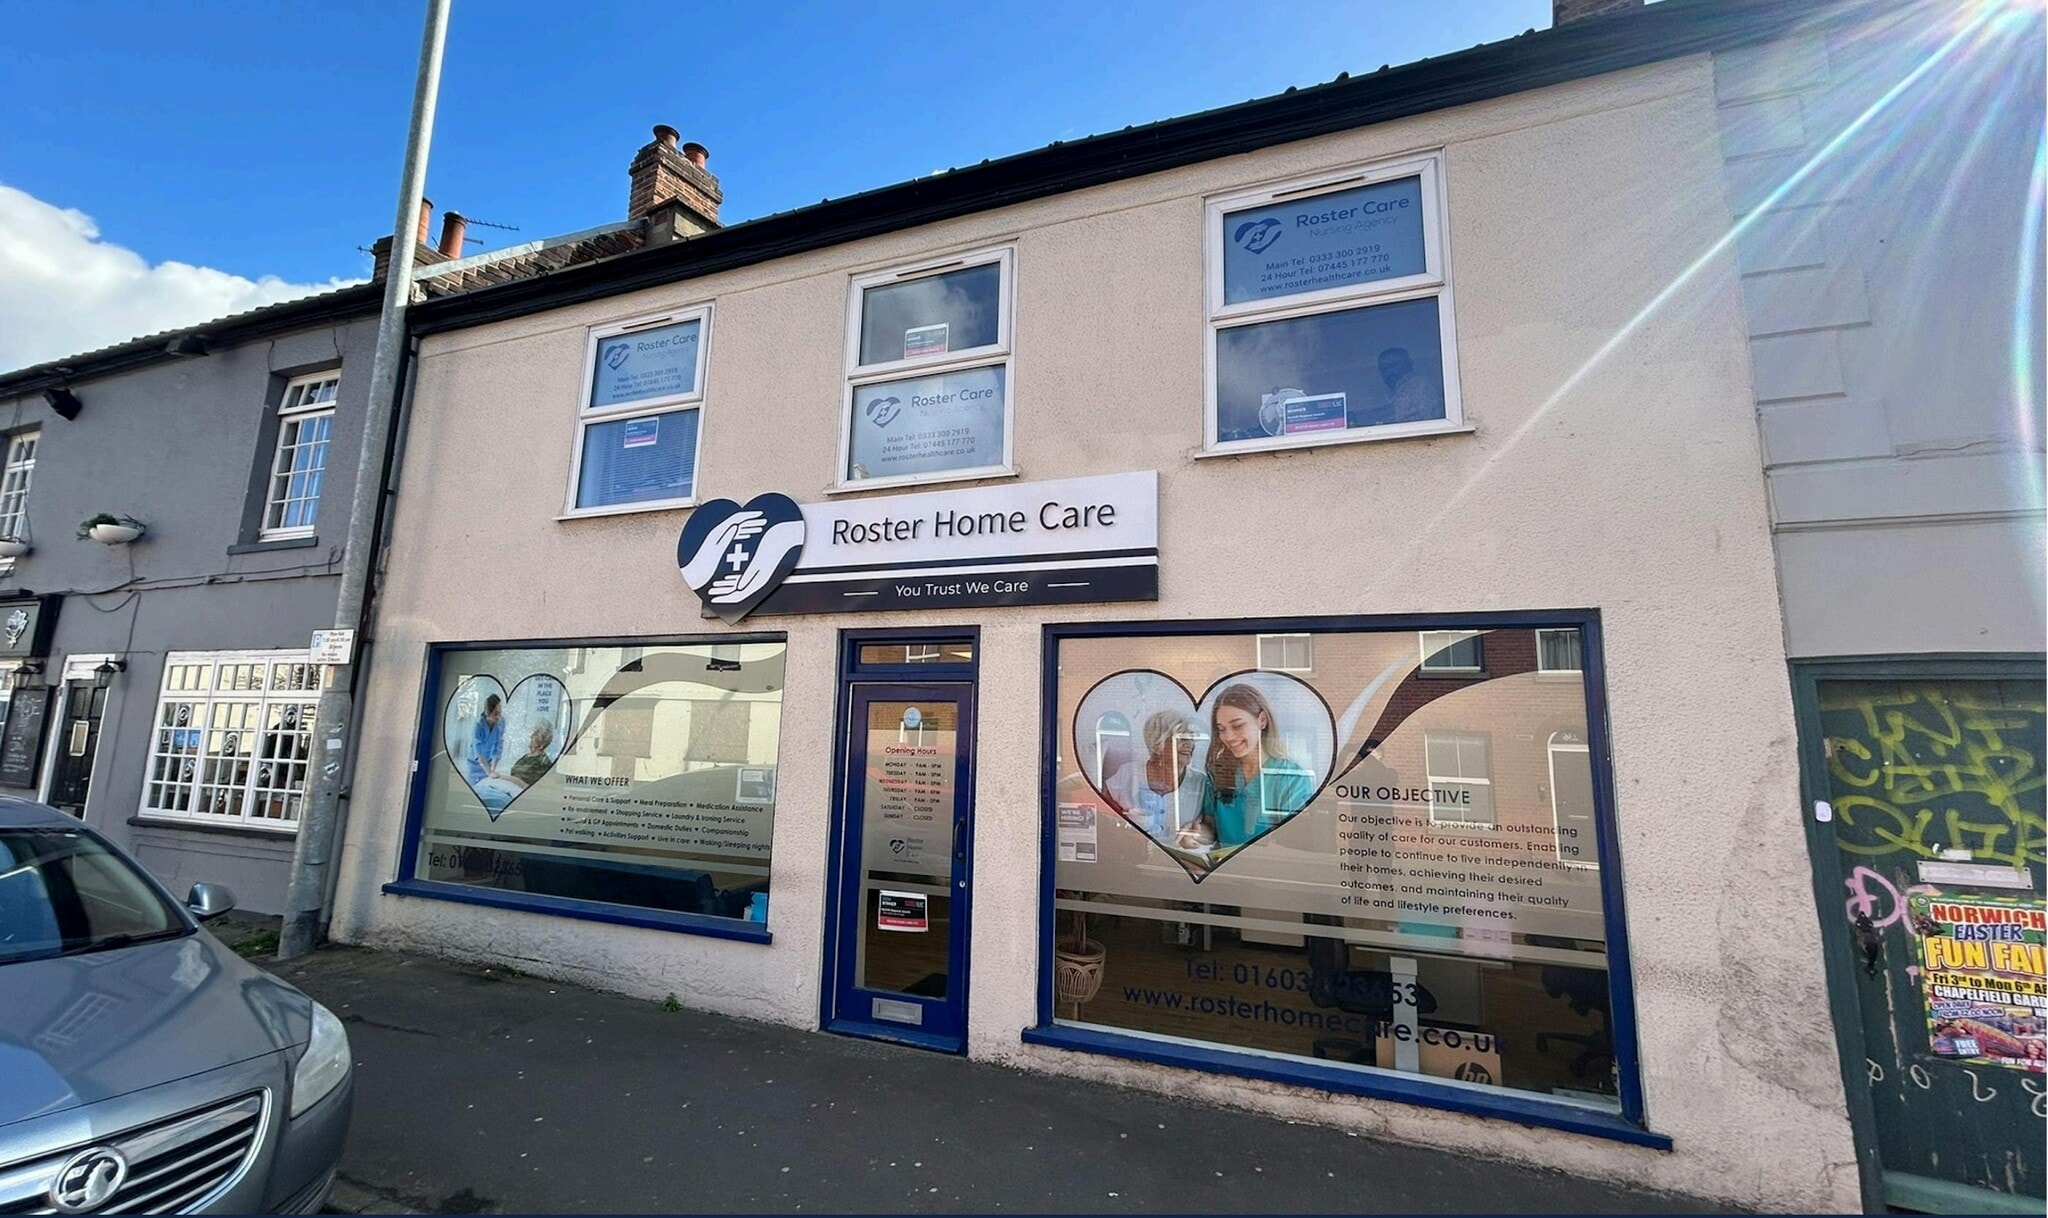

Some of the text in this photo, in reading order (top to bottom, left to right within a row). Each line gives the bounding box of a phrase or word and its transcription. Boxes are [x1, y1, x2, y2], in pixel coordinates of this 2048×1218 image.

[1296, 198, 1409, 228] Roster Care
[1310, 216, 1398, 238] Nursing Agency
[1266, 260, 1288, 270] Main
[1309, 251, 1333, 263] 0333
[1336, 248, 1353, 259] 300
[1356, 244, 1380, 256] 2919
[1261, 273, 1272, 282] 24
[1275, 270, 1296, 280] Hour
[1317, 261, 1348, 273] 07445
[1370, 253, 1389, 265] 770
[637, 334, 697, 352] Roster Care
[911, 388, 994, 408] Roster Care
[832, 501, 1116, 545] Roster Home Care
[895, 580, 1029, 597] You Trust We Care
[885, 746, 915, 756] Opening
[565, 775, 630, 787] WHAT WE OFFER
[1336, 785, 1470, 804] OUR OBJECTIVE
[616, 809, 641, 817] Shopping
[672, 813, 695, 821] Laundry
[696, 802, 730, 810] Medication
[731, 804, 763, 812] Assistance
[702, 826, 749, 837] Companionship
[1339, 814, 1358, 823] Our
[1360, 815, 1412, 827] objective
[1415, 818, 1423, 827] is
[1426, 819, 1437, 828] to
[1440, 820, 1484, 831] provide
[1487, 823, 1503, 832] an
[1339, 831, 1580, 856] quality of care for our customers. Enabing
[428, 852, 446, 868] Tel:
[1339, 847, 1378, 858] people
[1381, 849, 1392, 858] to
[1395, 851, 1444, 862] continue
[1447, 853, 1458, 863] to
[1461, 854, 1481, 864] live
[1340, 862, 1363, 872] their
[1409, 868, 1466, 882] achieving
[1469, 871, 1494, 882] their
[1498, 874, 1543, 886] desired
[1400, 885, 1422, 894] and
[1426, 886, 1495, 902] maintaining
[1498, 891, 1524, 902] their
[1528, 895, 1569, 908] quality
[1341, 896, 1517, 920] of life and lifestyle preferences.
[1931, 903, 2047, 930] NORWICH
[1954, 923, 2023, 941] EASTER
[1925, 937, 2047, 976] FUN FAI
[1184, 958, 1224, 982] Tel:
[1234, 963, 1312, 992] 01603
[1933, 973, 1948, 984] Fri
[1970, 977, 1982, 987] to
[1985, 978, 2012, 990] Mon
[1934, 985, 2011, 1004] CHAPELFIELD
